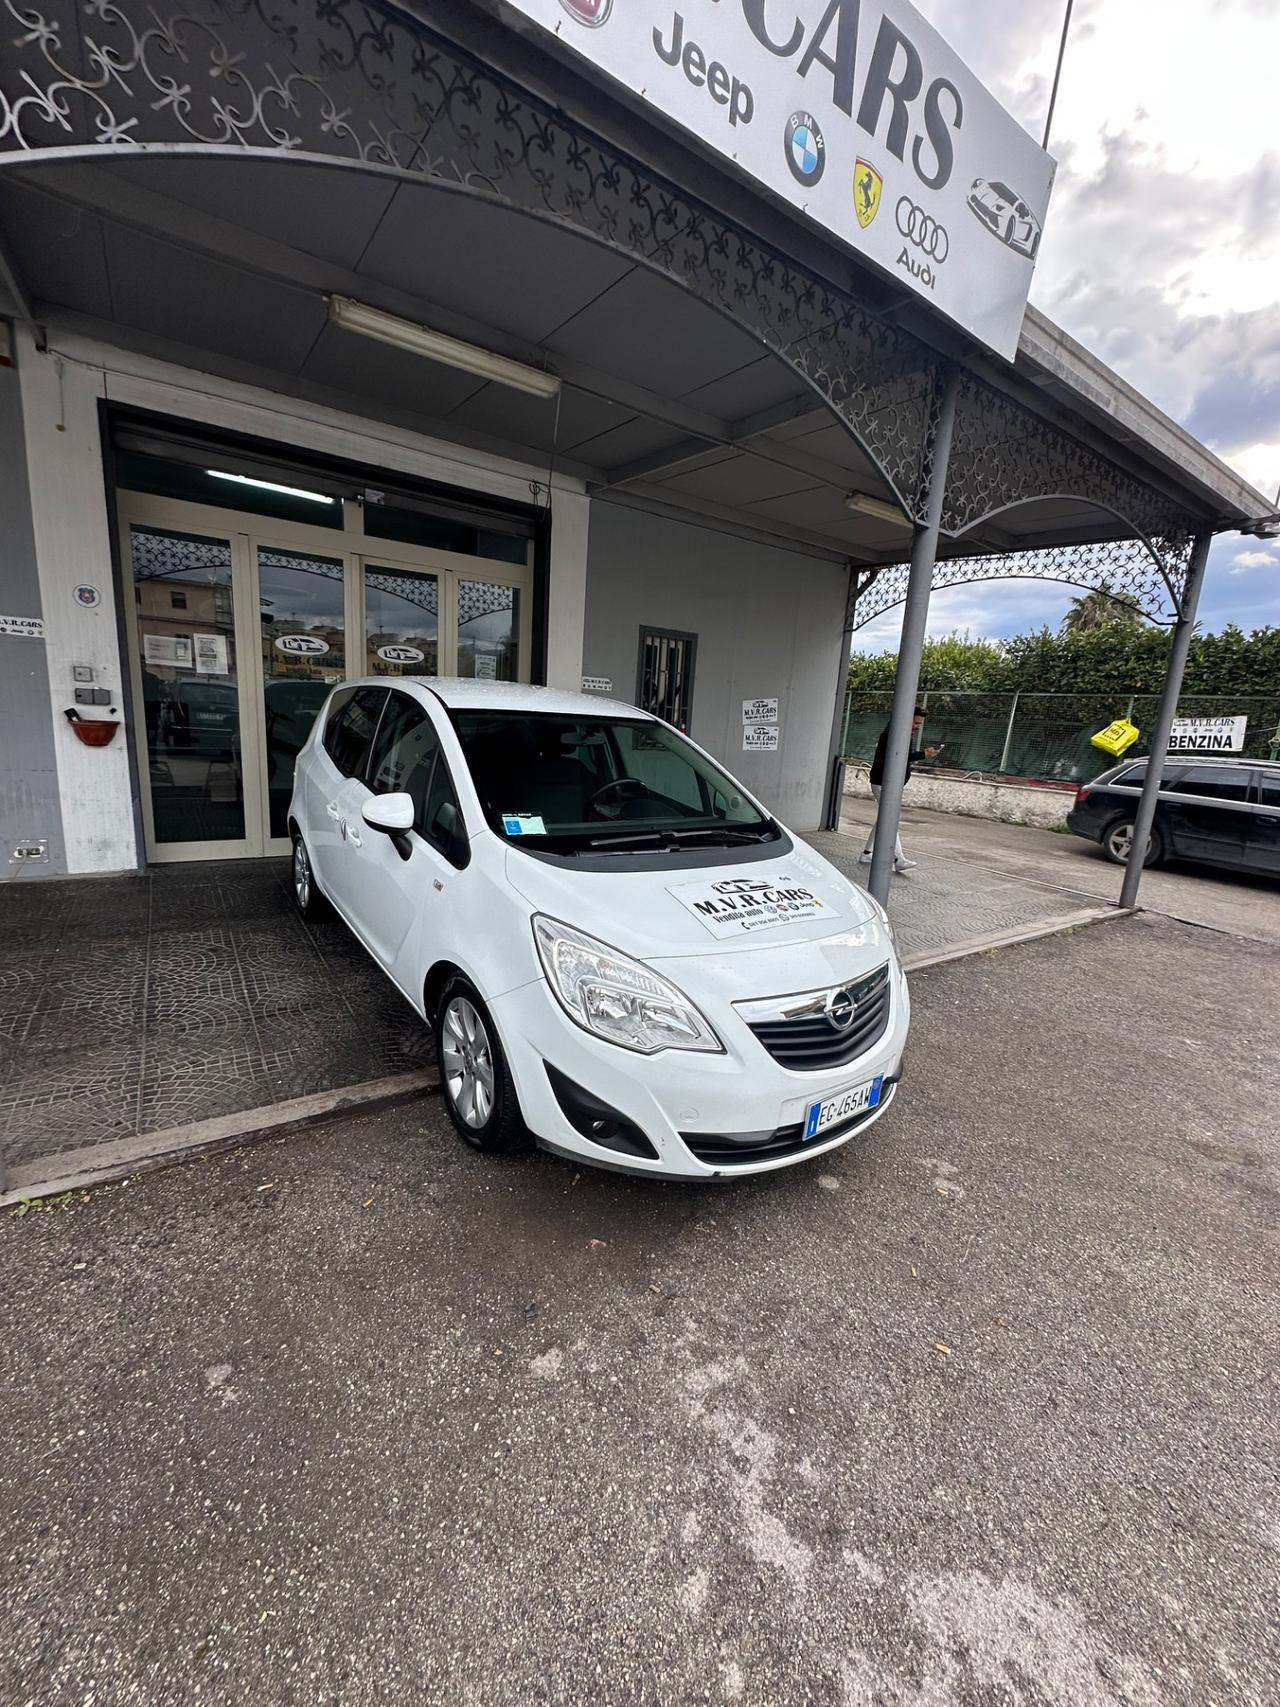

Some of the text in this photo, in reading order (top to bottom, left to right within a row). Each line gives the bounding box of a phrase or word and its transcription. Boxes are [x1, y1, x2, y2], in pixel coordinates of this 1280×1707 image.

[652, 11, 755, 128] Jeep
[790, 114, 825, 150] BMW
[896, 246, 937, 291] Audi
[1168, 735, 1233, 749] BENZINA
[693, 888, 814, 916] M.V.R.CARS
[712, 907, 764, 924] Vendita auto
